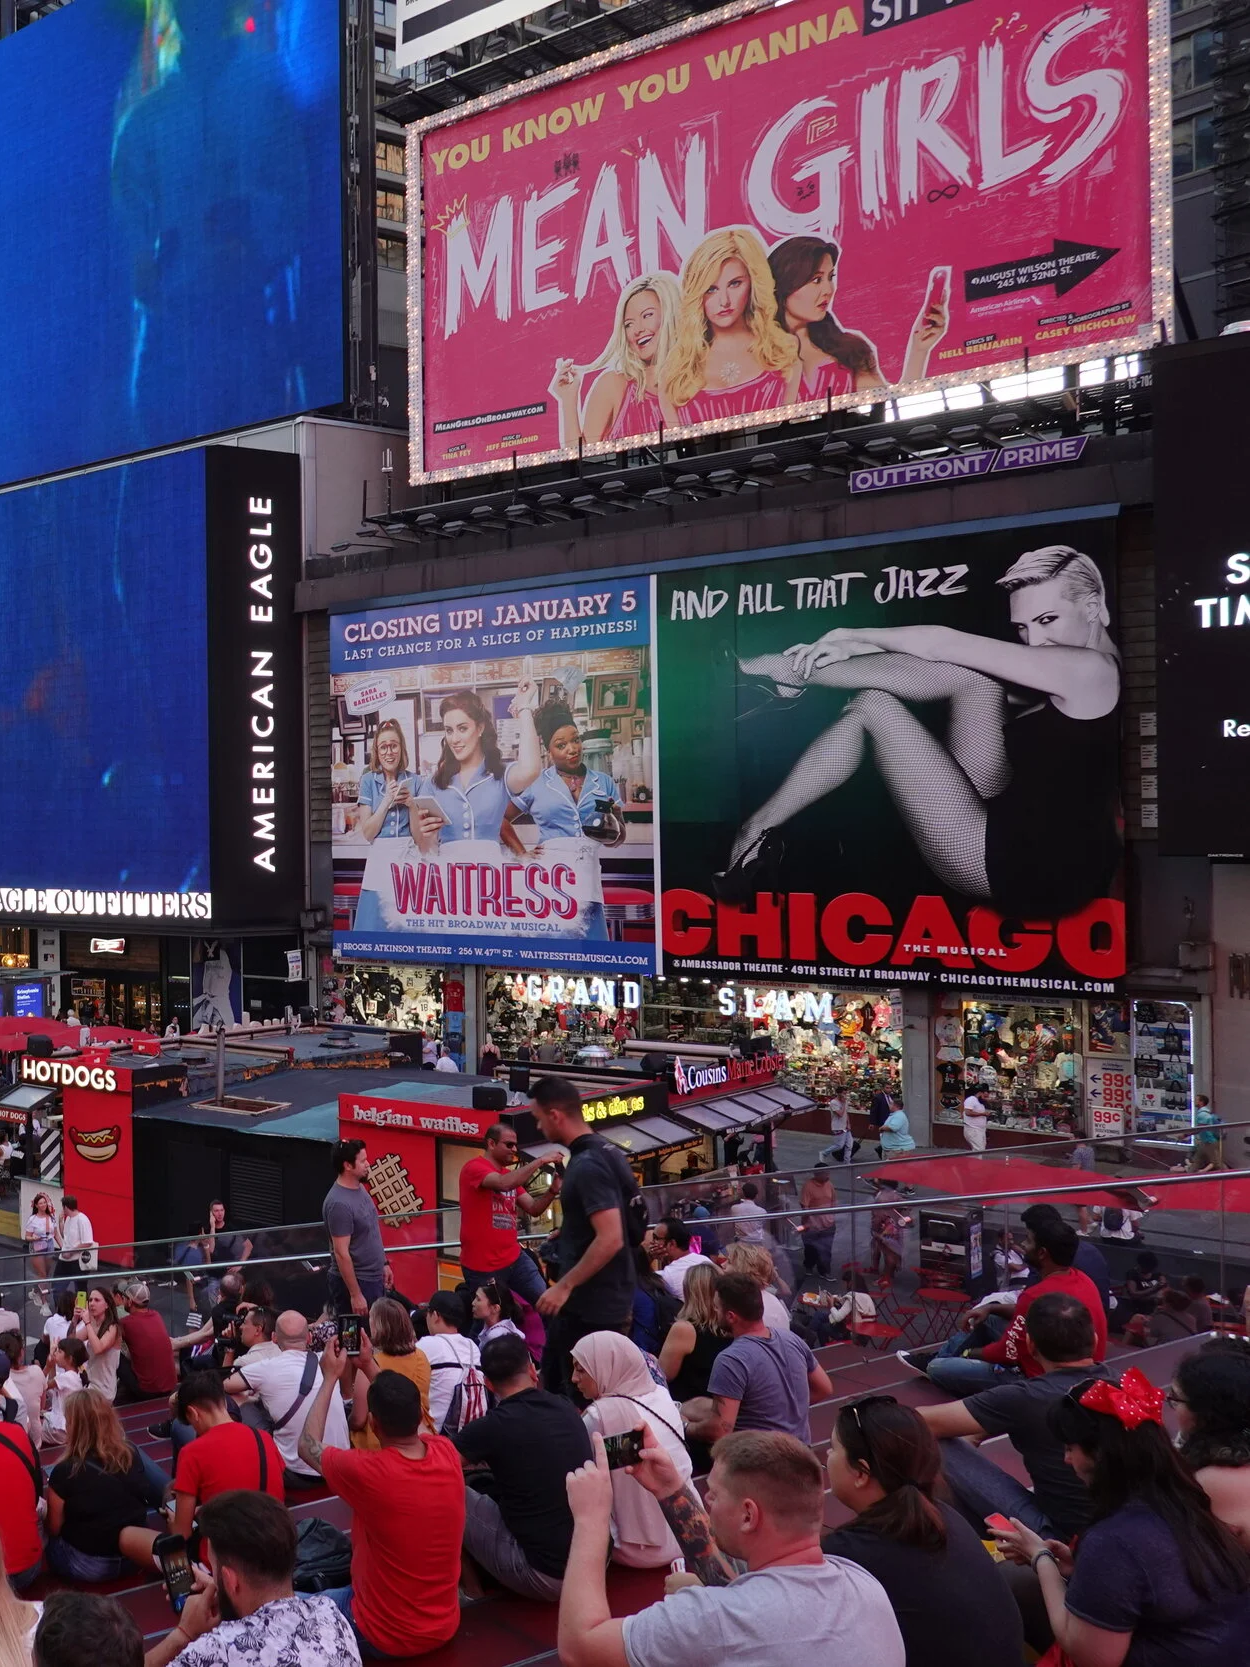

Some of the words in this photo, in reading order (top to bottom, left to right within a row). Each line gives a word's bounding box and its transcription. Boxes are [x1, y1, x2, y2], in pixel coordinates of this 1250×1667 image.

[430, 133, 491, 176] YOU
[502, 94, 606, 154] KNOW
[617, 64, 690, 111] YOU
[704, 6, 859, 82] WANNA
[444, 132, 707, 340] MEAN
[747, 7, 1124, 238] GIRLS
[979, 268, 1016, 284] AUGUST
[1017, 261, 1056, 277] WILSON
[996, 278, 1015, 289] 245
[1016, 277, 1030, 286] W.
[1031, 270, 1057, 284] 52ND
[1059, 265, 1073, 277] ST.
[969, 301, 1003, 315] American
[1003, 296, 1031, 308] Airlines
[965, 336, 985, 347] LYRICS
[986, 334, 994, 342] BY
[1035, 326, 1071, 341] CASEY
[1073, 314, 1137, 333] NICHOLAW
[938, 348, 964, 360] NELL
[965, 336, 1023, 355] BENJAMIN
[458, 449, 472, 459] FEY
[485, 442, 500, 452] JEFF
[501, 434, 539, 450] RICHMOND
[855, 453, 987, 490] OUTFRONT
[1003, 441, 1078, 467] PRIME
[249, 496, 272, 622] EAGLE
[670, 587, 729, 621] AND
[737, 584, 785, 616] ALL
[787, 571, 867, 610] THAT
[873, 564, 969, 604] JAZZ
[344, 613, 440, 643] CLOSING
[449, 609, 483, 631] UP!
[491, 592, 612, 627] JANUARY
[621, 590, 637, 613] 5
[344, 647, 374, 661] LAST
[378, 642, 431, 658] CHANCE
[436, 638, 462, 651] FOR
[467, 636, 477, 648] A
[482, 631, 520, 646] SLICE
[526, 629, 545, 641] OF
[550, 620, 638, 640] HAPPINESS!
[251, 651, 276, 872] AMERICAN
[53, 889, 211, 919] OUTFITTERS
[390, 862, 578, 920] WAITRESS
[406, 919, 425, 927] THE
[428, 919, 446, 928] HIT
[448, 920, 507, 931] BROADWAY
[511, 921, 561, 933] MUSICAL
[662, 888, 1126, 979] CHICAGO
[343, 942, 372, 952] BROOKS
[374, 943, 415, 954] ATKINSON
[416, 945, 452, 955] THEATRE
[458, 947, 473, 956] 256
[502, 949, 514, 958] ST.
[520, 949, 649, 966] WAITRESSTHEMUSICAL.COM
[903, 944, 930, 953] THE
[937, 945, 1008, 957] MUSICAL
[681, 959, 741, 971] AMBASSADOR
[743, 962, 783, 973] THEATRE
[790, 965, 817, 975] 49TH
[819, 966, 856, 978] STREET
[858, 969, 871, 979] AT
[874, 969, 931, 982] BROADWAY
[940, 973, 1115, 993] CHICAGOTHEMUSICAL.COM
[526, 975, 641, 1008] GRAND
[718, 987, 834, 1023] SLAM
[23, 1058, 117, 1092] HOTDOGS
[687, 1062, 727, 1090] Cousins
[9, 1111, 26, 1121] DOGS
[352, 1105, 414, 1127] belgian
[419, 1116, 480, 1135] waffles
[596, 1101, 607, 1119] &
